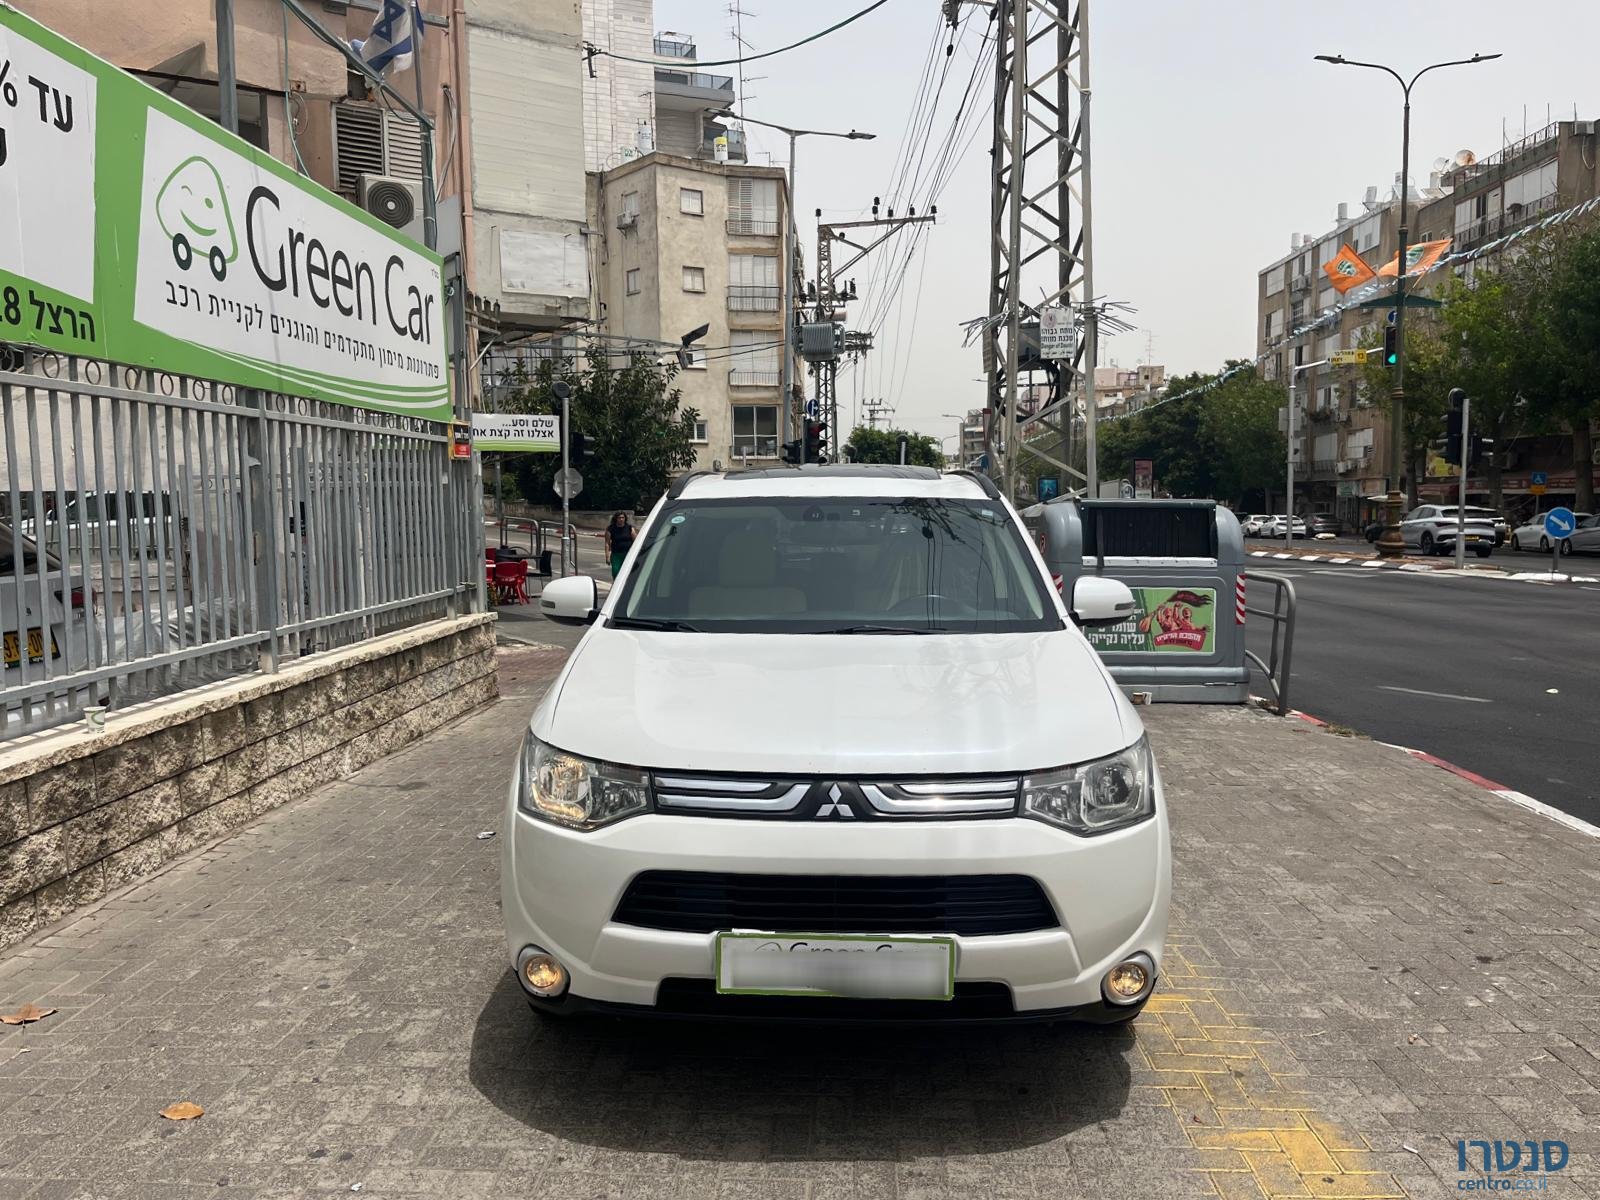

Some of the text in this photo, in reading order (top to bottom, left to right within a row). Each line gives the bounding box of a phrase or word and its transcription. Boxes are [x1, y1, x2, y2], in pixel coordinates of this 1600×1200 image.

[28, 75, 74, 133] עד
[246, 186, 434, 345] Green Car
[28, 289, 96, 342] הרצל
[165, 280, 440, 379] פתרונות מימון מתקדמים והוגנים לקניית רכב
[532, 418, 554, 428] שלם
[489, 428, 511, 440] קצת
[513, 429, 525, 438] זה
[527, 428, 554, 438] אצלנו
[1120, 633, 1145, 645] עליה
